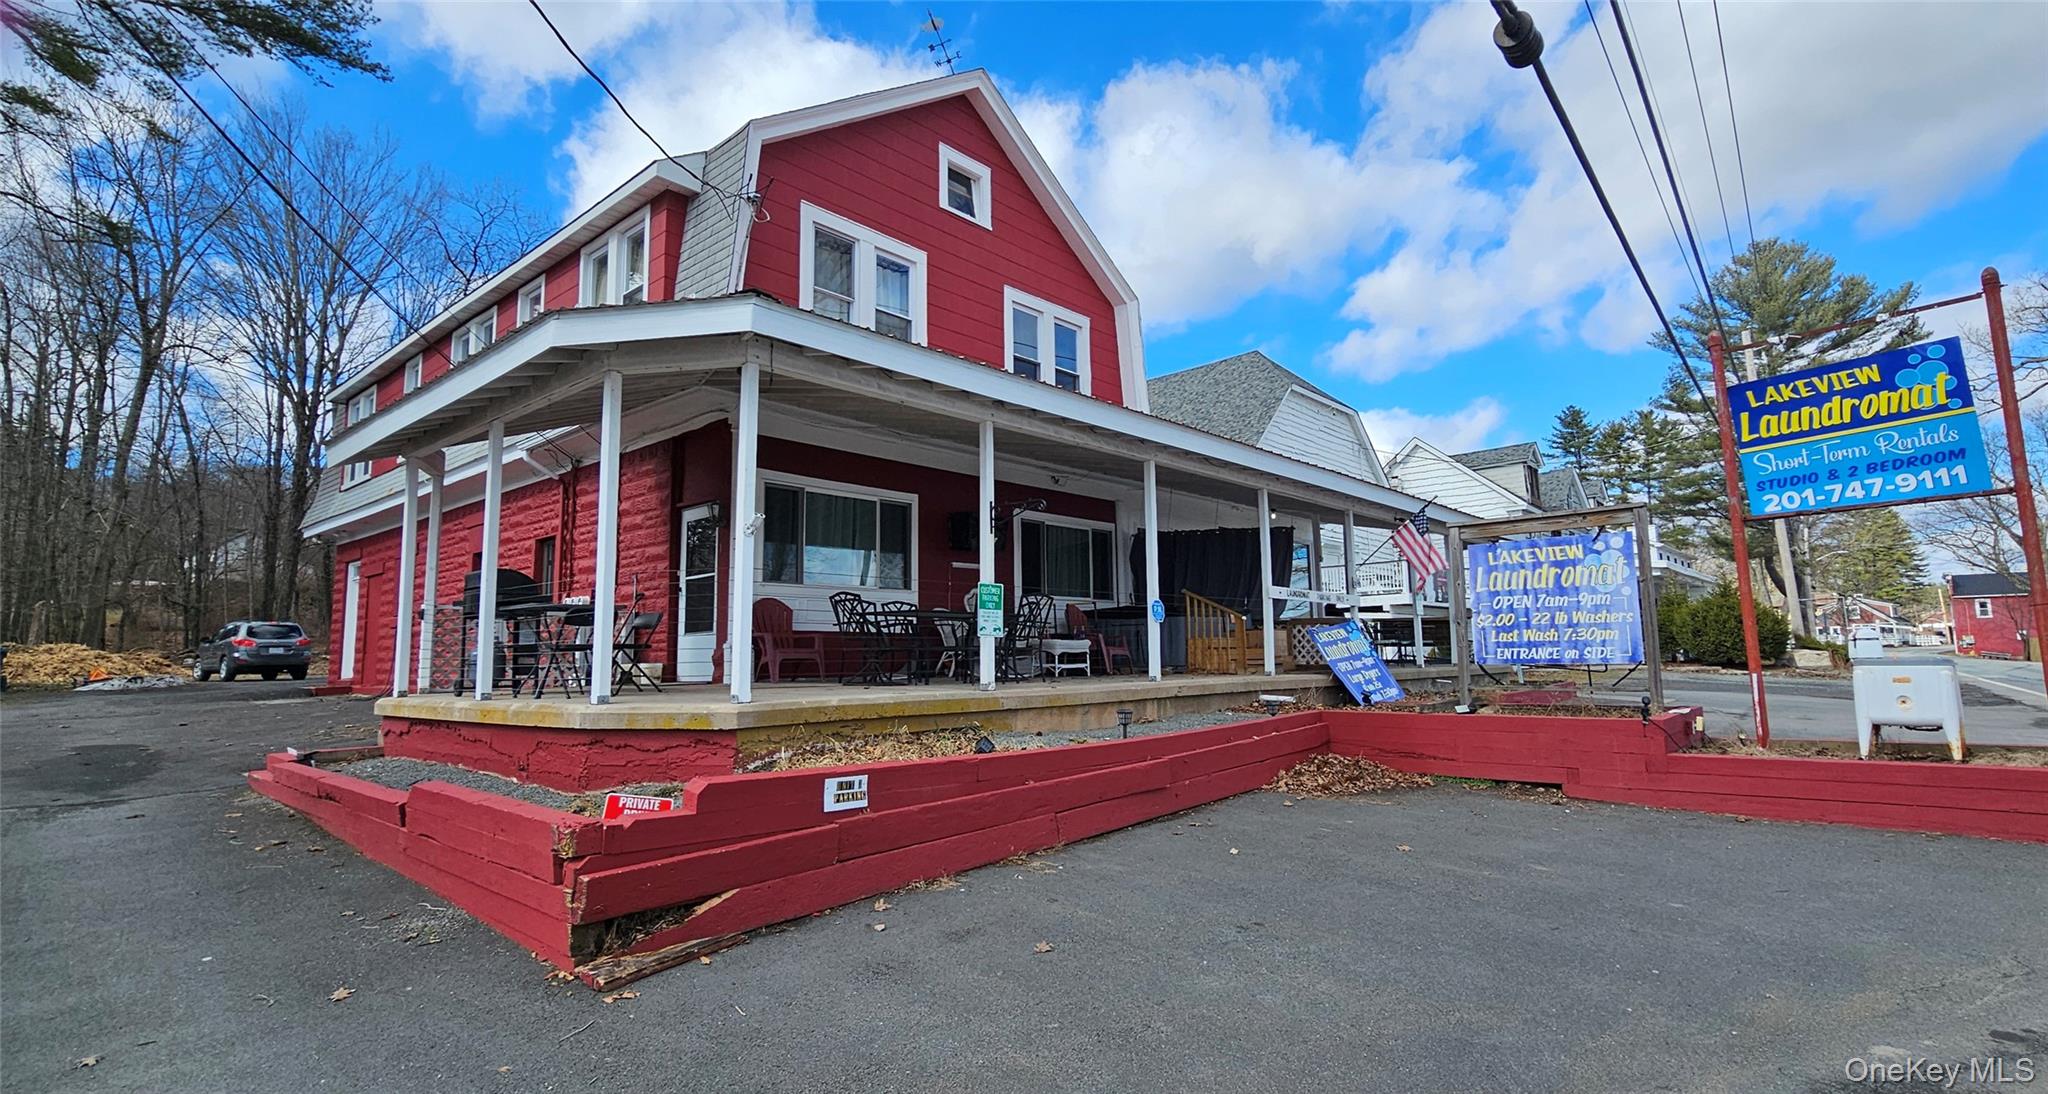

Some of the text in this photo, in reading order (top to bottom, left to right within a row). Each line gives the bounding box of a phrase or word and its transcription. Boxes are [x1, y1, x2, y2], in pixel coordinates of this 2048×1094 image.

[1746, 364, 1881, 408] LAKEVIEW
[1740, 372, 1950, 443] Laundromat
[1753, 423, 1959, 476] Short-Term Rentals
[1756, 448, 1967, 493] STUDIO & 2 BEDROOM
[1762, 464, 1968, 513] 201-747-9111
[1488, 544, 1584, 566] LAKEVIEW
[1475, 556, 1627, 592] Laundromat
[1493, 595, 1535, 609] OPEN
[1477, 613, 1515, 628] $2.00
[1532, 613, 1549, 625] 22
[1554, 613, 1568, 625] lb
[1572, 611, 1634, 624] Washers
[1491, 627, 1619, 643] Last Wash 7:30pm
[1496, 646, 1617, 660] ENTRANCE on SIDE
[619, 797, 661, 810] PRIVATE
[834, 791, 866, 803] PARKING
